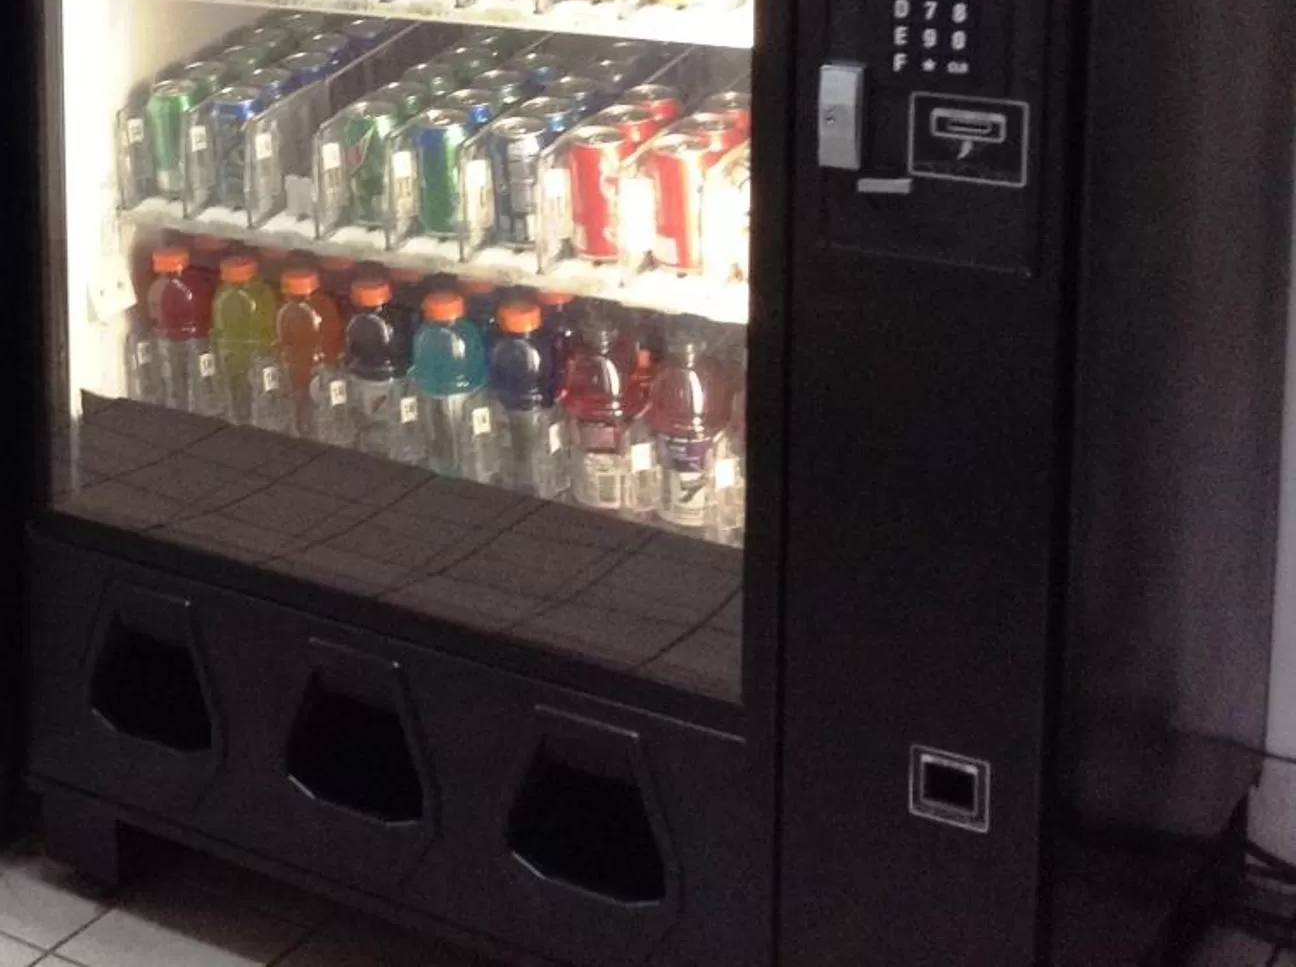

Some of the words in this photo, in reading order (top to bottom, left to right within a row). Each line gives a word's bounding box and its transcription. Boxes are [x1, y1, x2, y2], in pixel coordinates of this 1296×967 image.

[924, 1, 938, 20] 7
[894, 26, 908, 45] E
[893, 53, 907, 72] F
